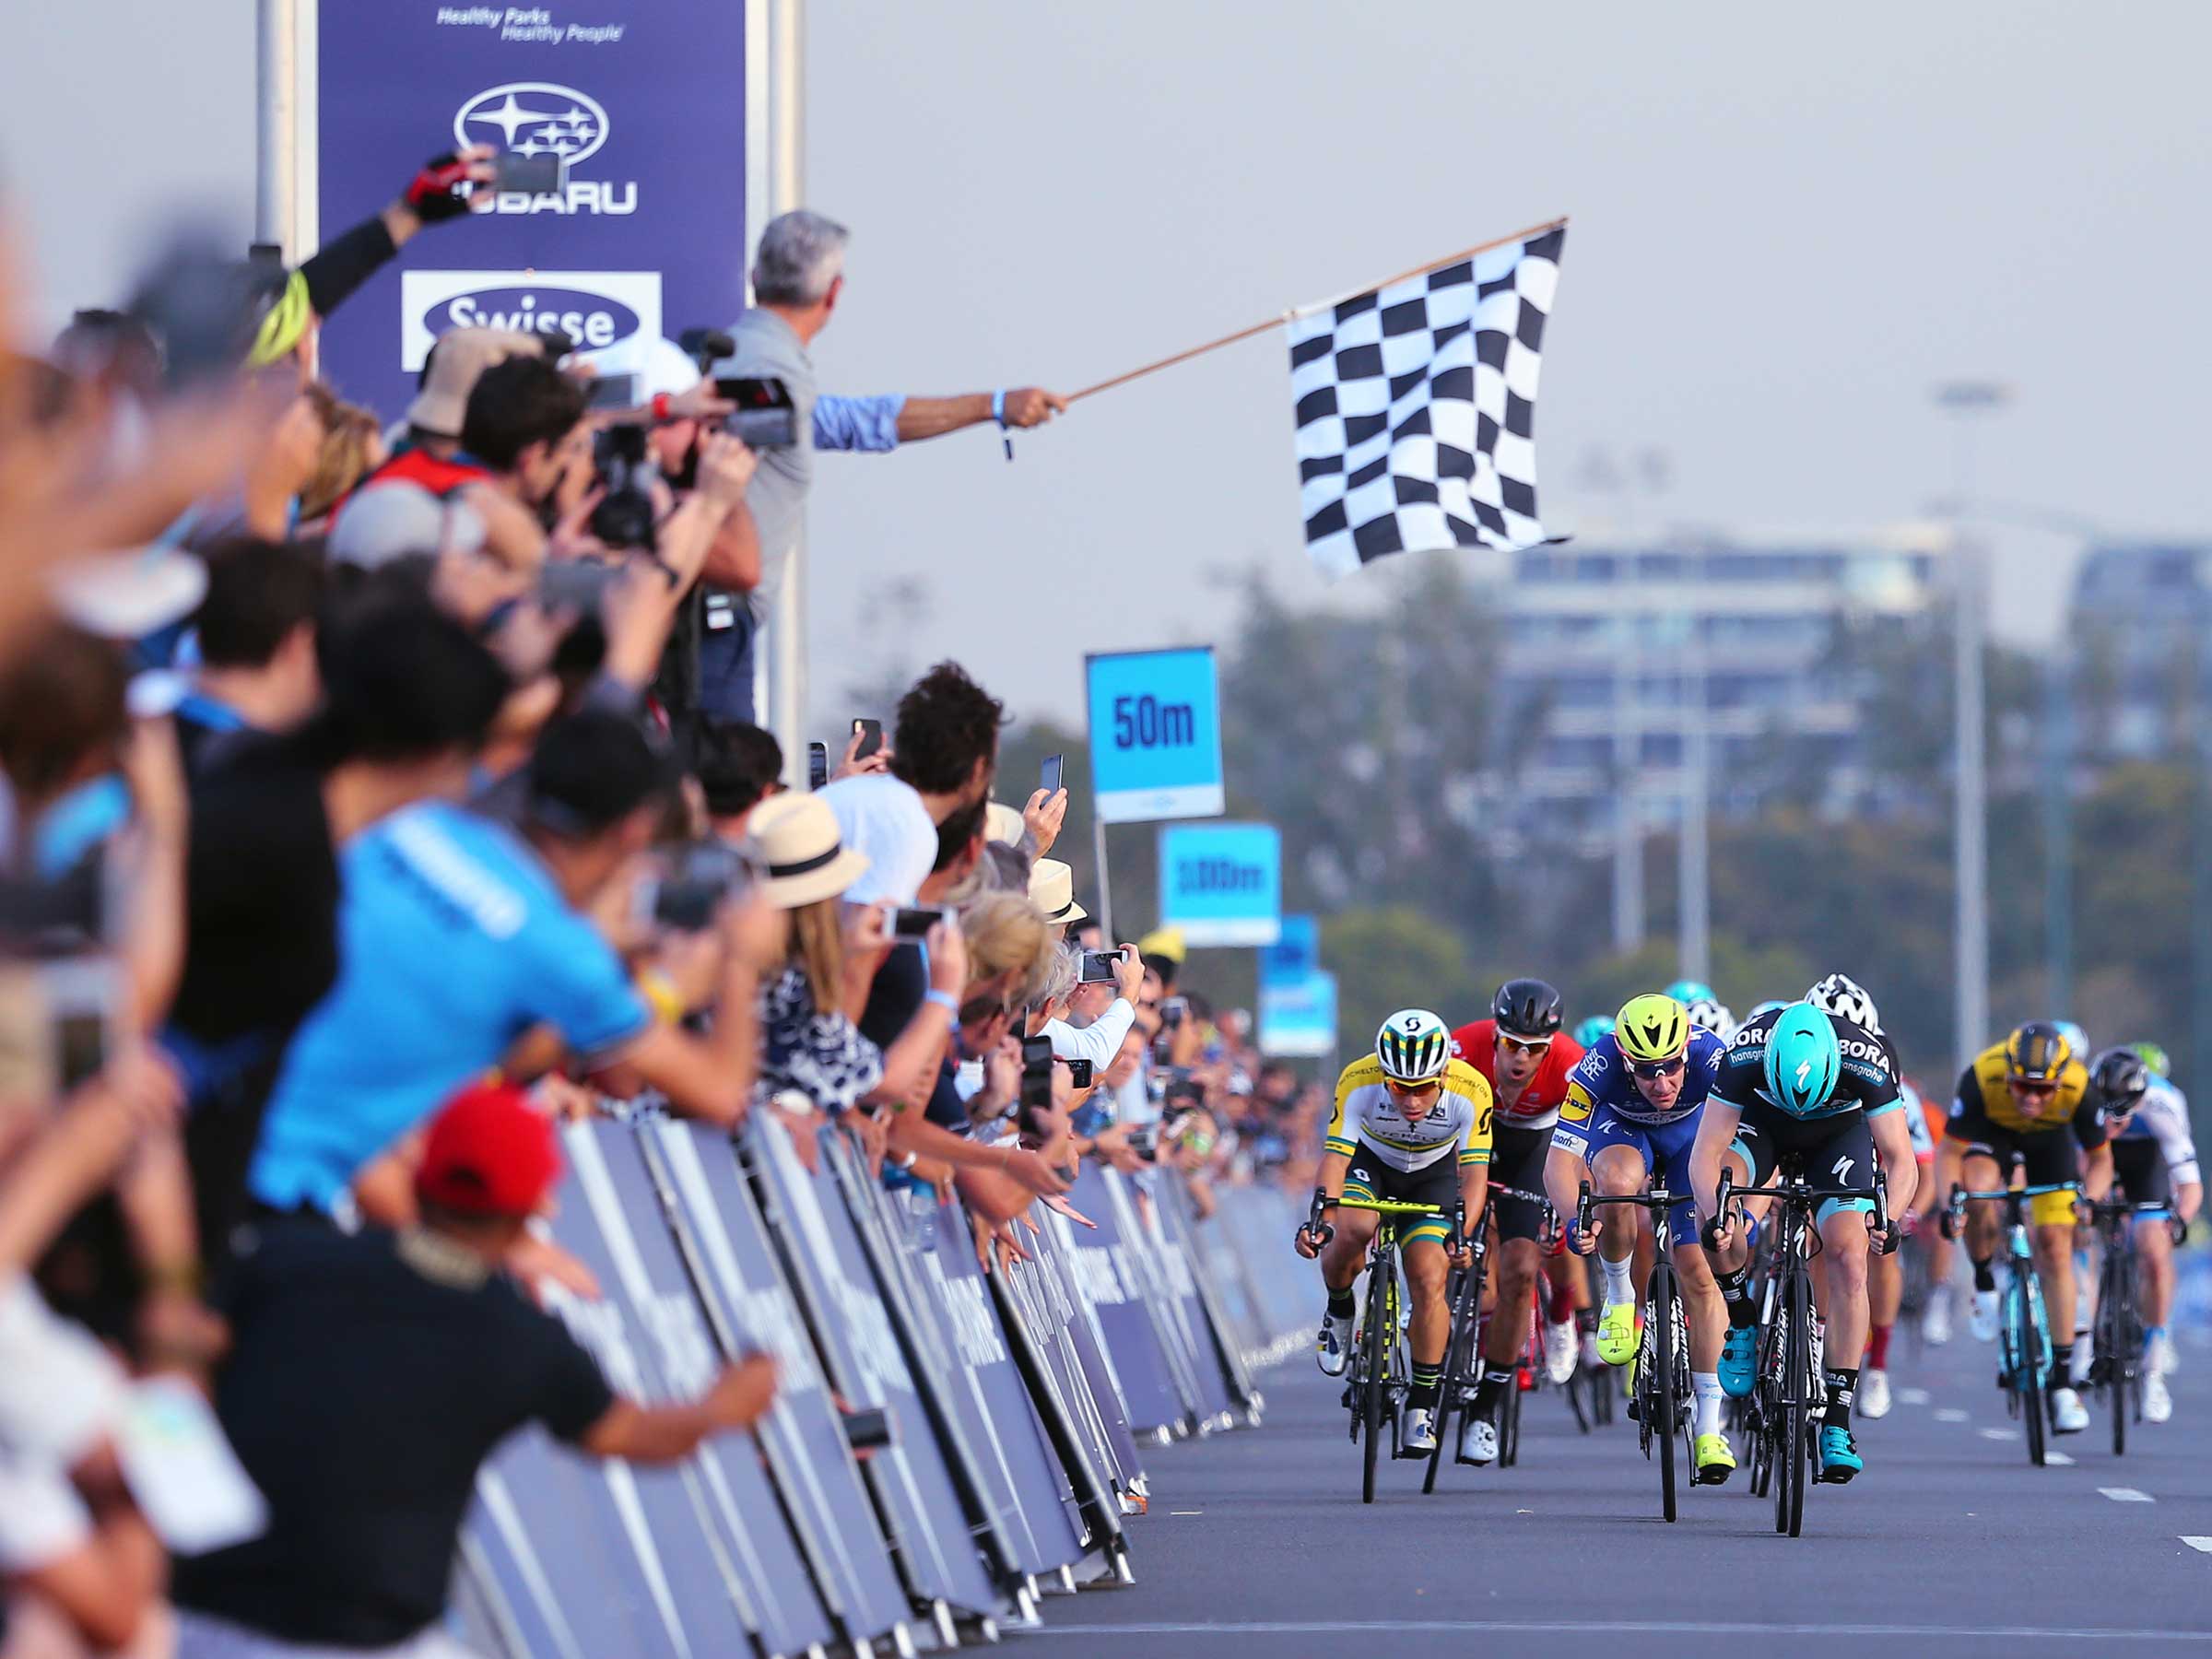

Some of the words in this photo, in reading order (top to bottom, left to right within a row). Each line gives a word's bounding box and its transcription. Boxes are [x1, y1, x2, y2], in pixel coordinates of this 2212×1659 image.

[437, 7, 503, 29] Healthy
[505, 6, 550, 25] Parks
[500, 24, 566, 45] Healthy
[566, 23, 623, 44] People
[452, 181, 638, 215] BARU
[1114, 694, 1194, 750] 50m
[1584, 1055, 1608, 1082] PRO
[1730, 1048, 1764, 1064] hansgro
[1840, 1040, 1889, 1074] BORA
[1842, 1062, 1884, 1083] ansgrohe
